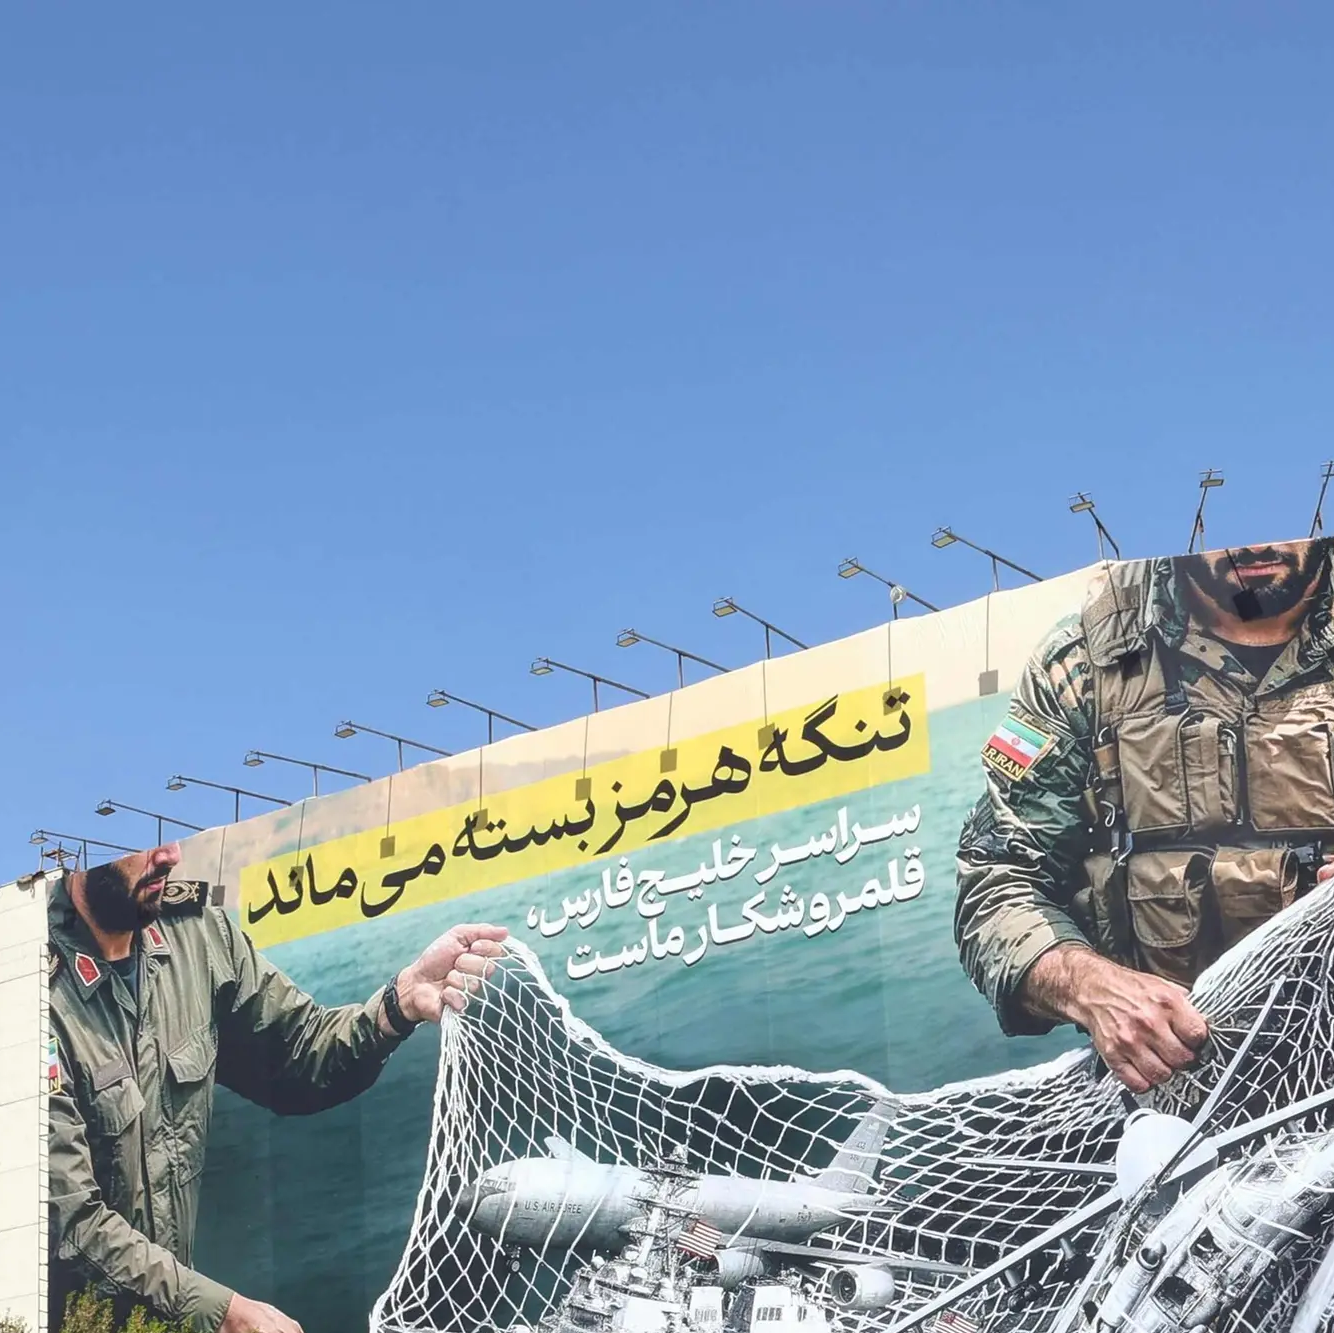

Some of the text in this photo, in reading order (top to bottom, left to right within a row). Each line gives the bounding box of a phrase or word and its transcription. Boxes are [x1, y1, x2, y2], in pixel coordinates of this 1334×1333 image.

[759, 691, 912, 776] تنگه
[452, 796, 595, 861] بسته
[593, 744, 752, 855] هرمز
[637, 834, 757, 917] خلیج
[754, 804, 921, 883] سراسر
[683, 884, 805, 966] شکار
[803, 846, 926, 937] قلمرو
